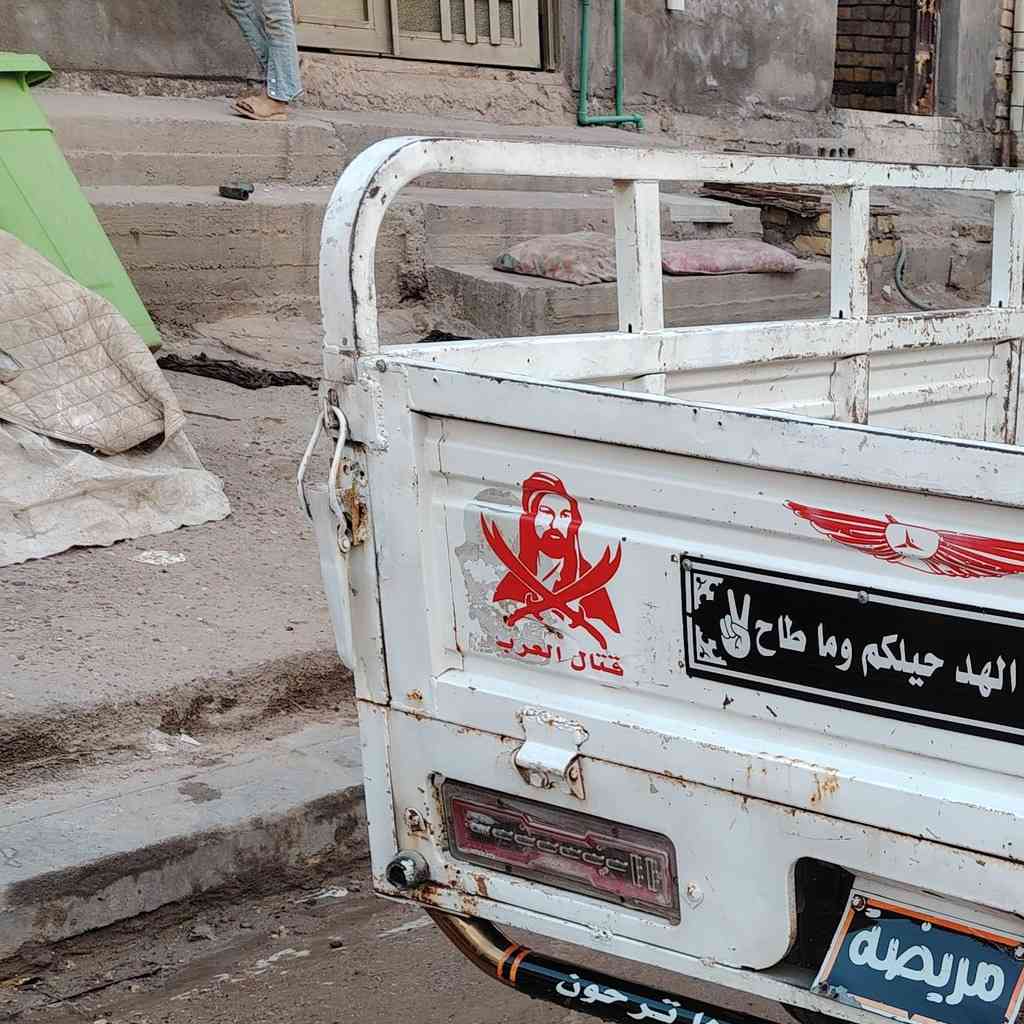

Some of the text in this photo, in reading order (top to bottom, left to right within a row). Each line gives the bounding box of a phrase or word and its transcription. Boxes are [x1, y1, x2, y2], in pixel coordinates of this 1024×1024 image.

[755, 616, 807, 657] طاح
[818, 623, 852, 672] وما
[571, 651, 624, 677] قتال
[862, 634, 944, 687] حيلكم
[955, 653, 1016, 698] الهد
